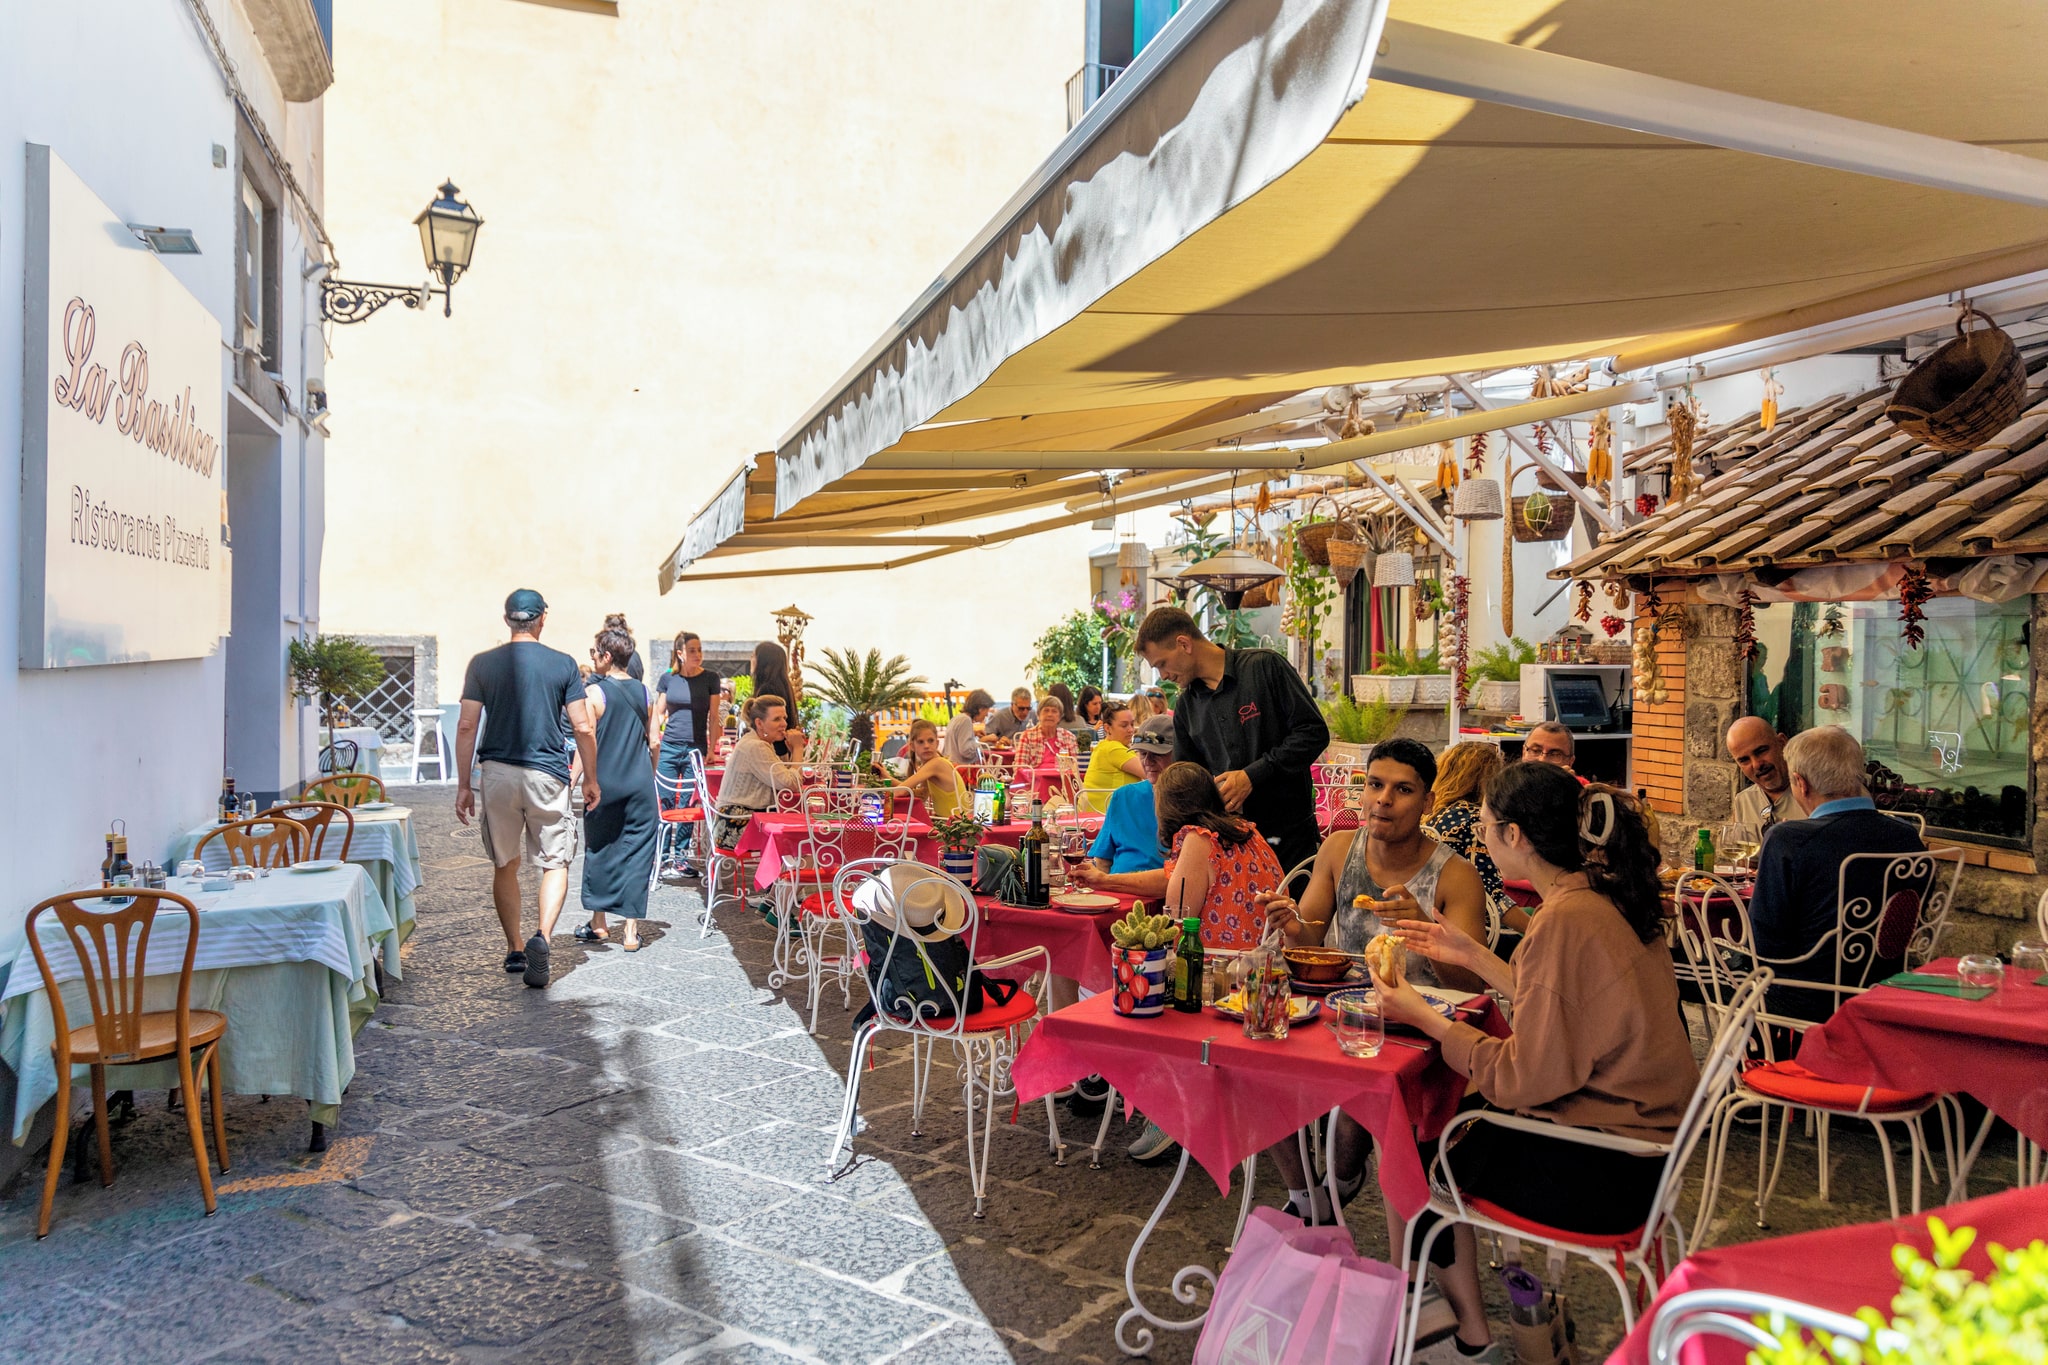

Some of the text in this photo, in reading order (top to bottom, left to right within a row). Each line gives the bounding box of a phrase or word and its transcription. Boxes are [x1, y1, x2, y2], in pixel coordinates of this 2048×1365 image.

[55, 296, 218, 478] La Basilica
[71, 484, 209, 570] Ristorante Pizzeria
